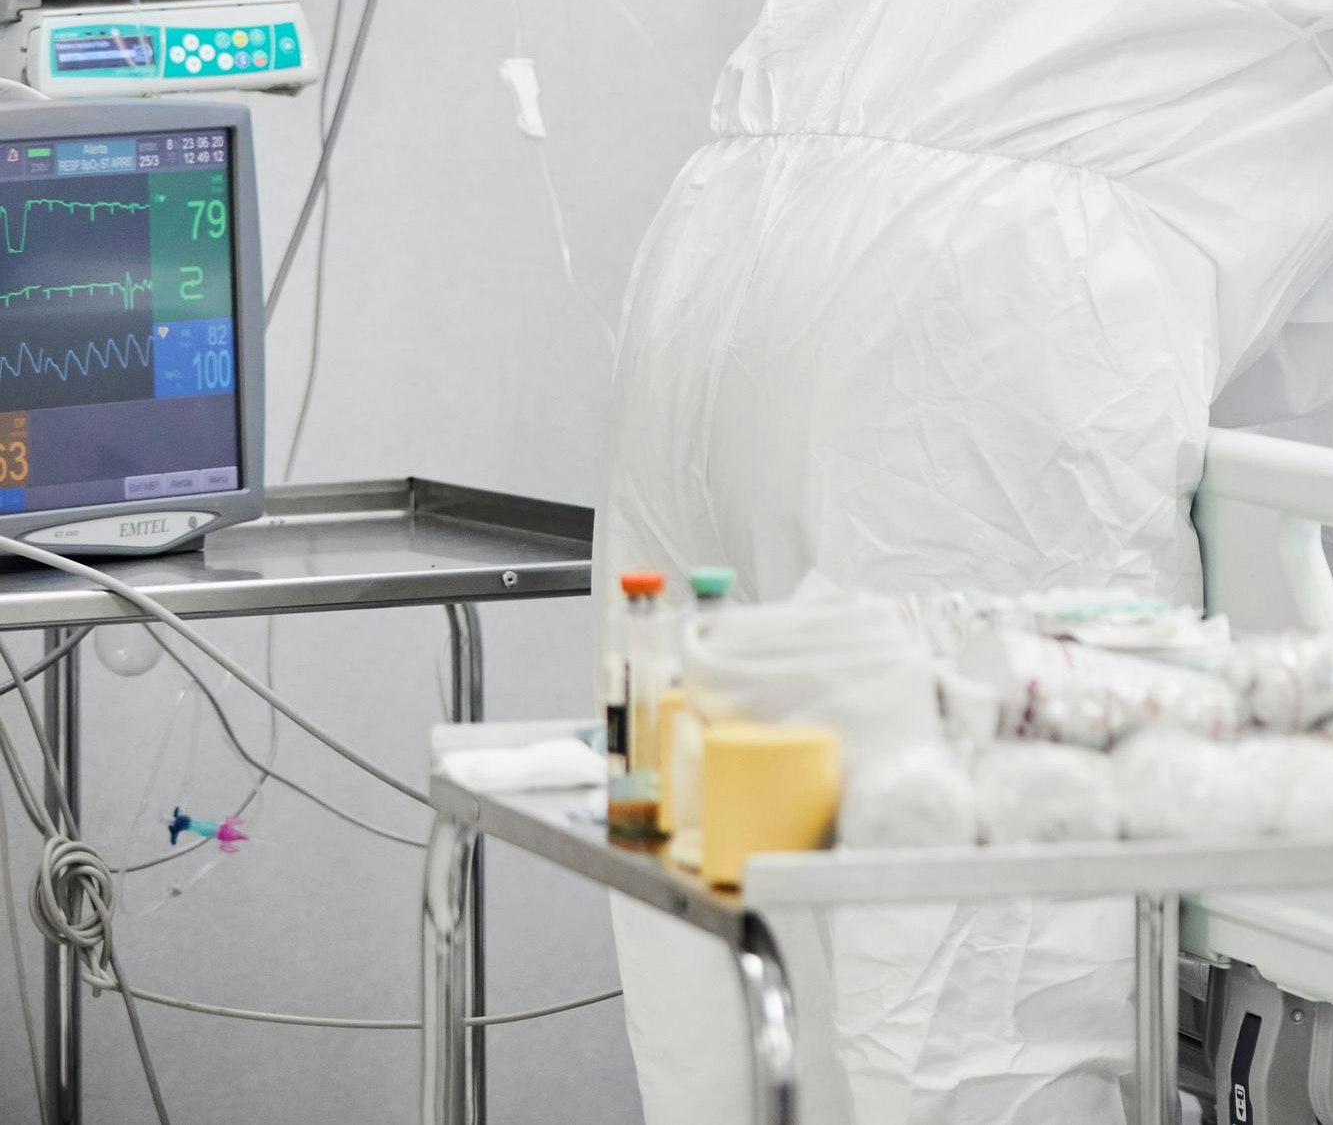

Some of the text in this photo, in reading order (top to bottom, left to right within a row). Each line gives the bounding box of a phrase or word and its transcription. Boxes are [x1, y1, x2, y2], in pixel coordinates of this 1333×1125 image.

[187, 199, 227, 240] 79
[179, 266, 204, 300] 2
[208, 325, 228, 346] 82
[193, 349, 232, 391] 100
[119, 518, 170, 538] EMTEL
